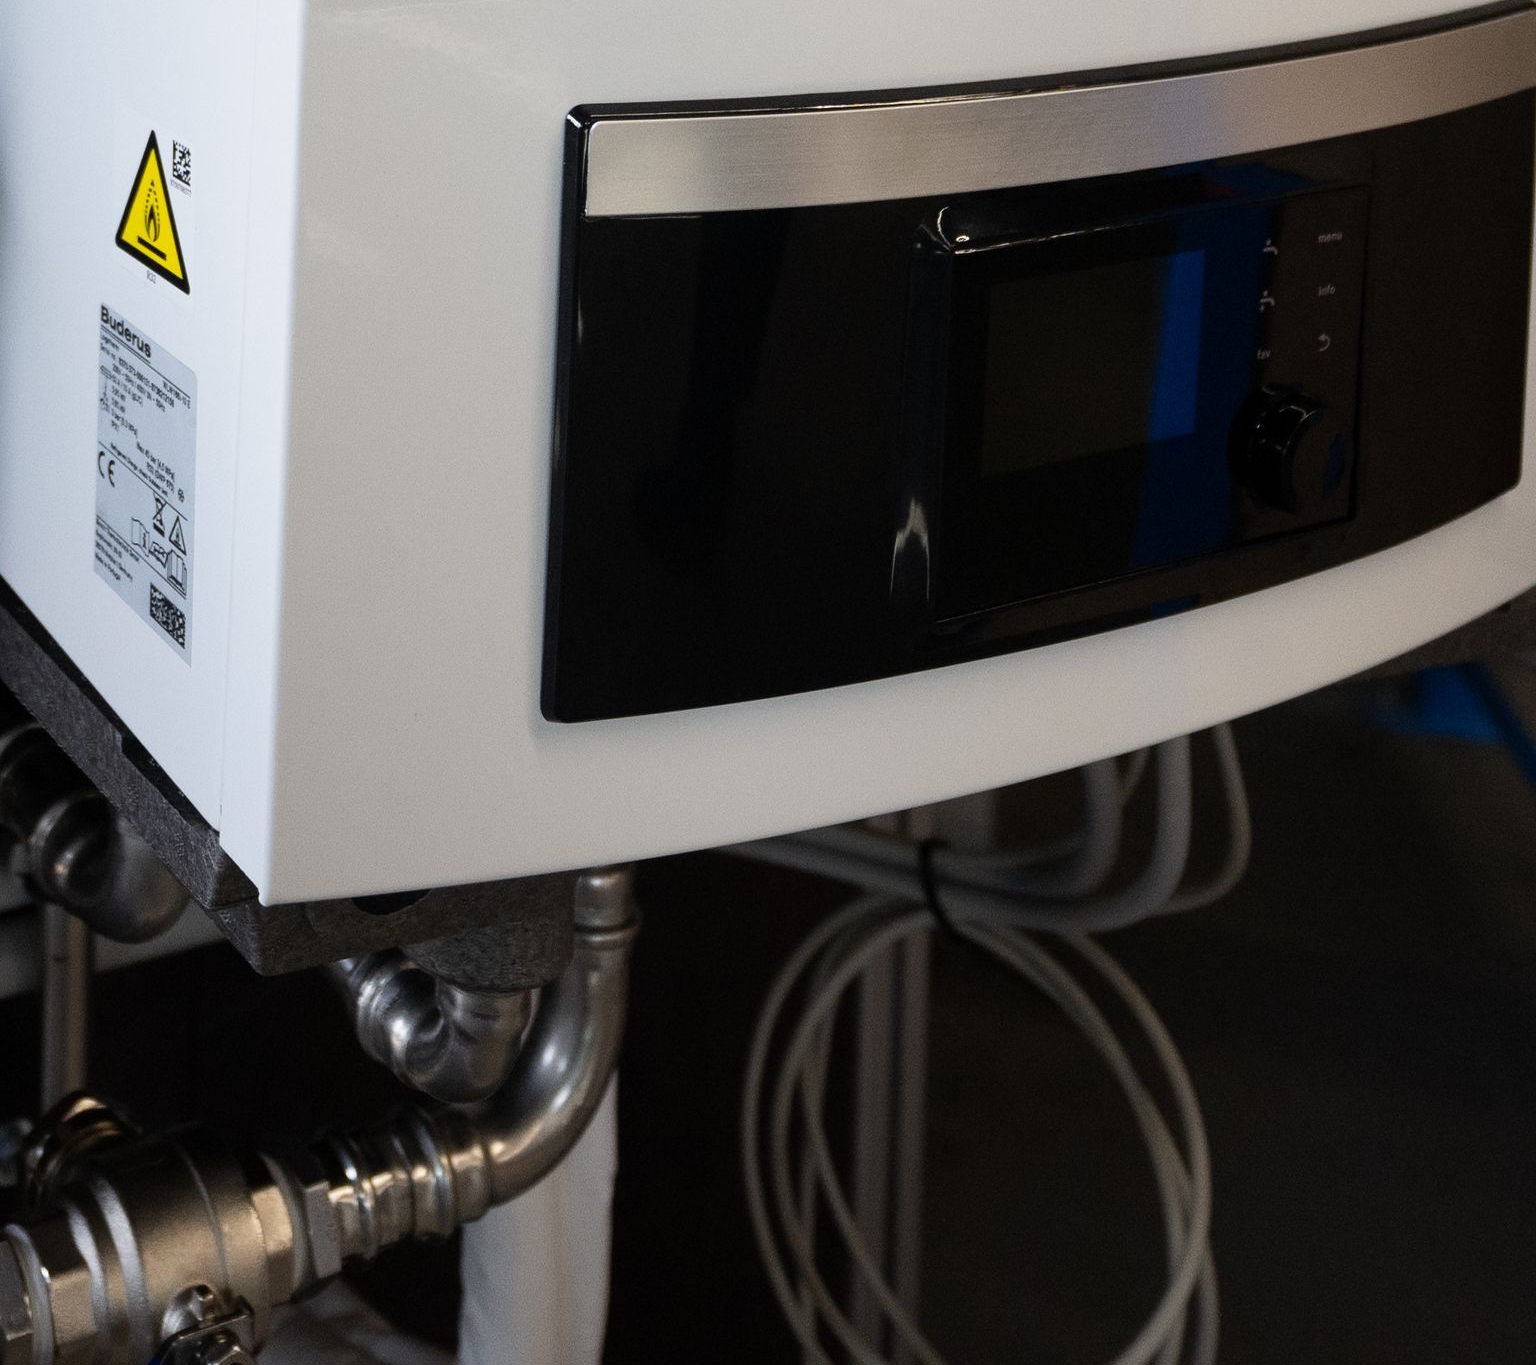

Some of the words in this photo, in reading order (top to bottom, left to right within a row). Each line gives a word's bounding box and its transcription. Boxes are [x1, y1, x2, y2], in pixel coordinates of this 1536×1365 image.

[1317, 232, 1344, 244] menu
[1317, 284, 1336, 297] info
[101, 304, 152, 359] Buderus
[1256, 349, 1272, 360] fav
[98, 451, 116, 489] CE
